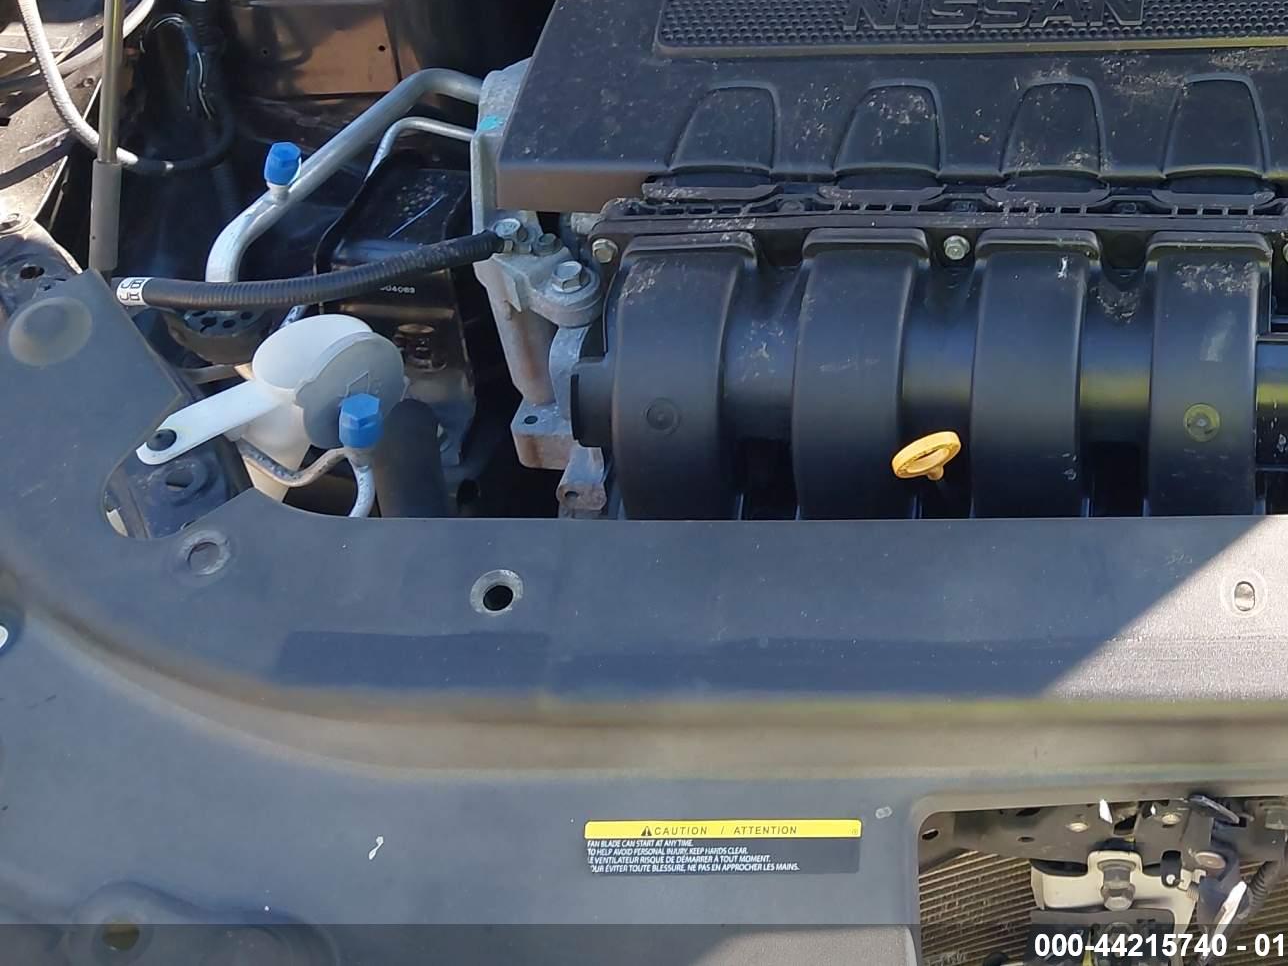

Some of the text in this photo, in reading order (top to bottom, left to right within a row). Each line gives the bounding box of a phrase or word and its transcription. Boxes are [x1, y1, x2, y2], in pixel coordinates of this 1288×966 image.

[120, 278, 146, 289] JB
[654, 827, 708, 835] CAUTION
[733, 826, 797, 835] ATTENTION
[588, 848, 596, 856] TO
[597, 848, 613, 856] HELP
[613, 848, 633, 856] AVOID
[634, 848, 665, 856] PERSONAL
[690, 848, 704, 856] KEEP
[705, 847, 727, 855] HANDS
[594, 856, 639, 864] VENTILATEUR
[640, 856, 664, 864] RISQUE
[666, 856, 675, 864] DE
[720, 855, 738, 863] TOUT
[629, 864, 651, 872] TOUTE
[688, 864, 696, 872] NE
[721, 863, 762, 871] APPROCHER
[763, 863, 775, 871] LES
